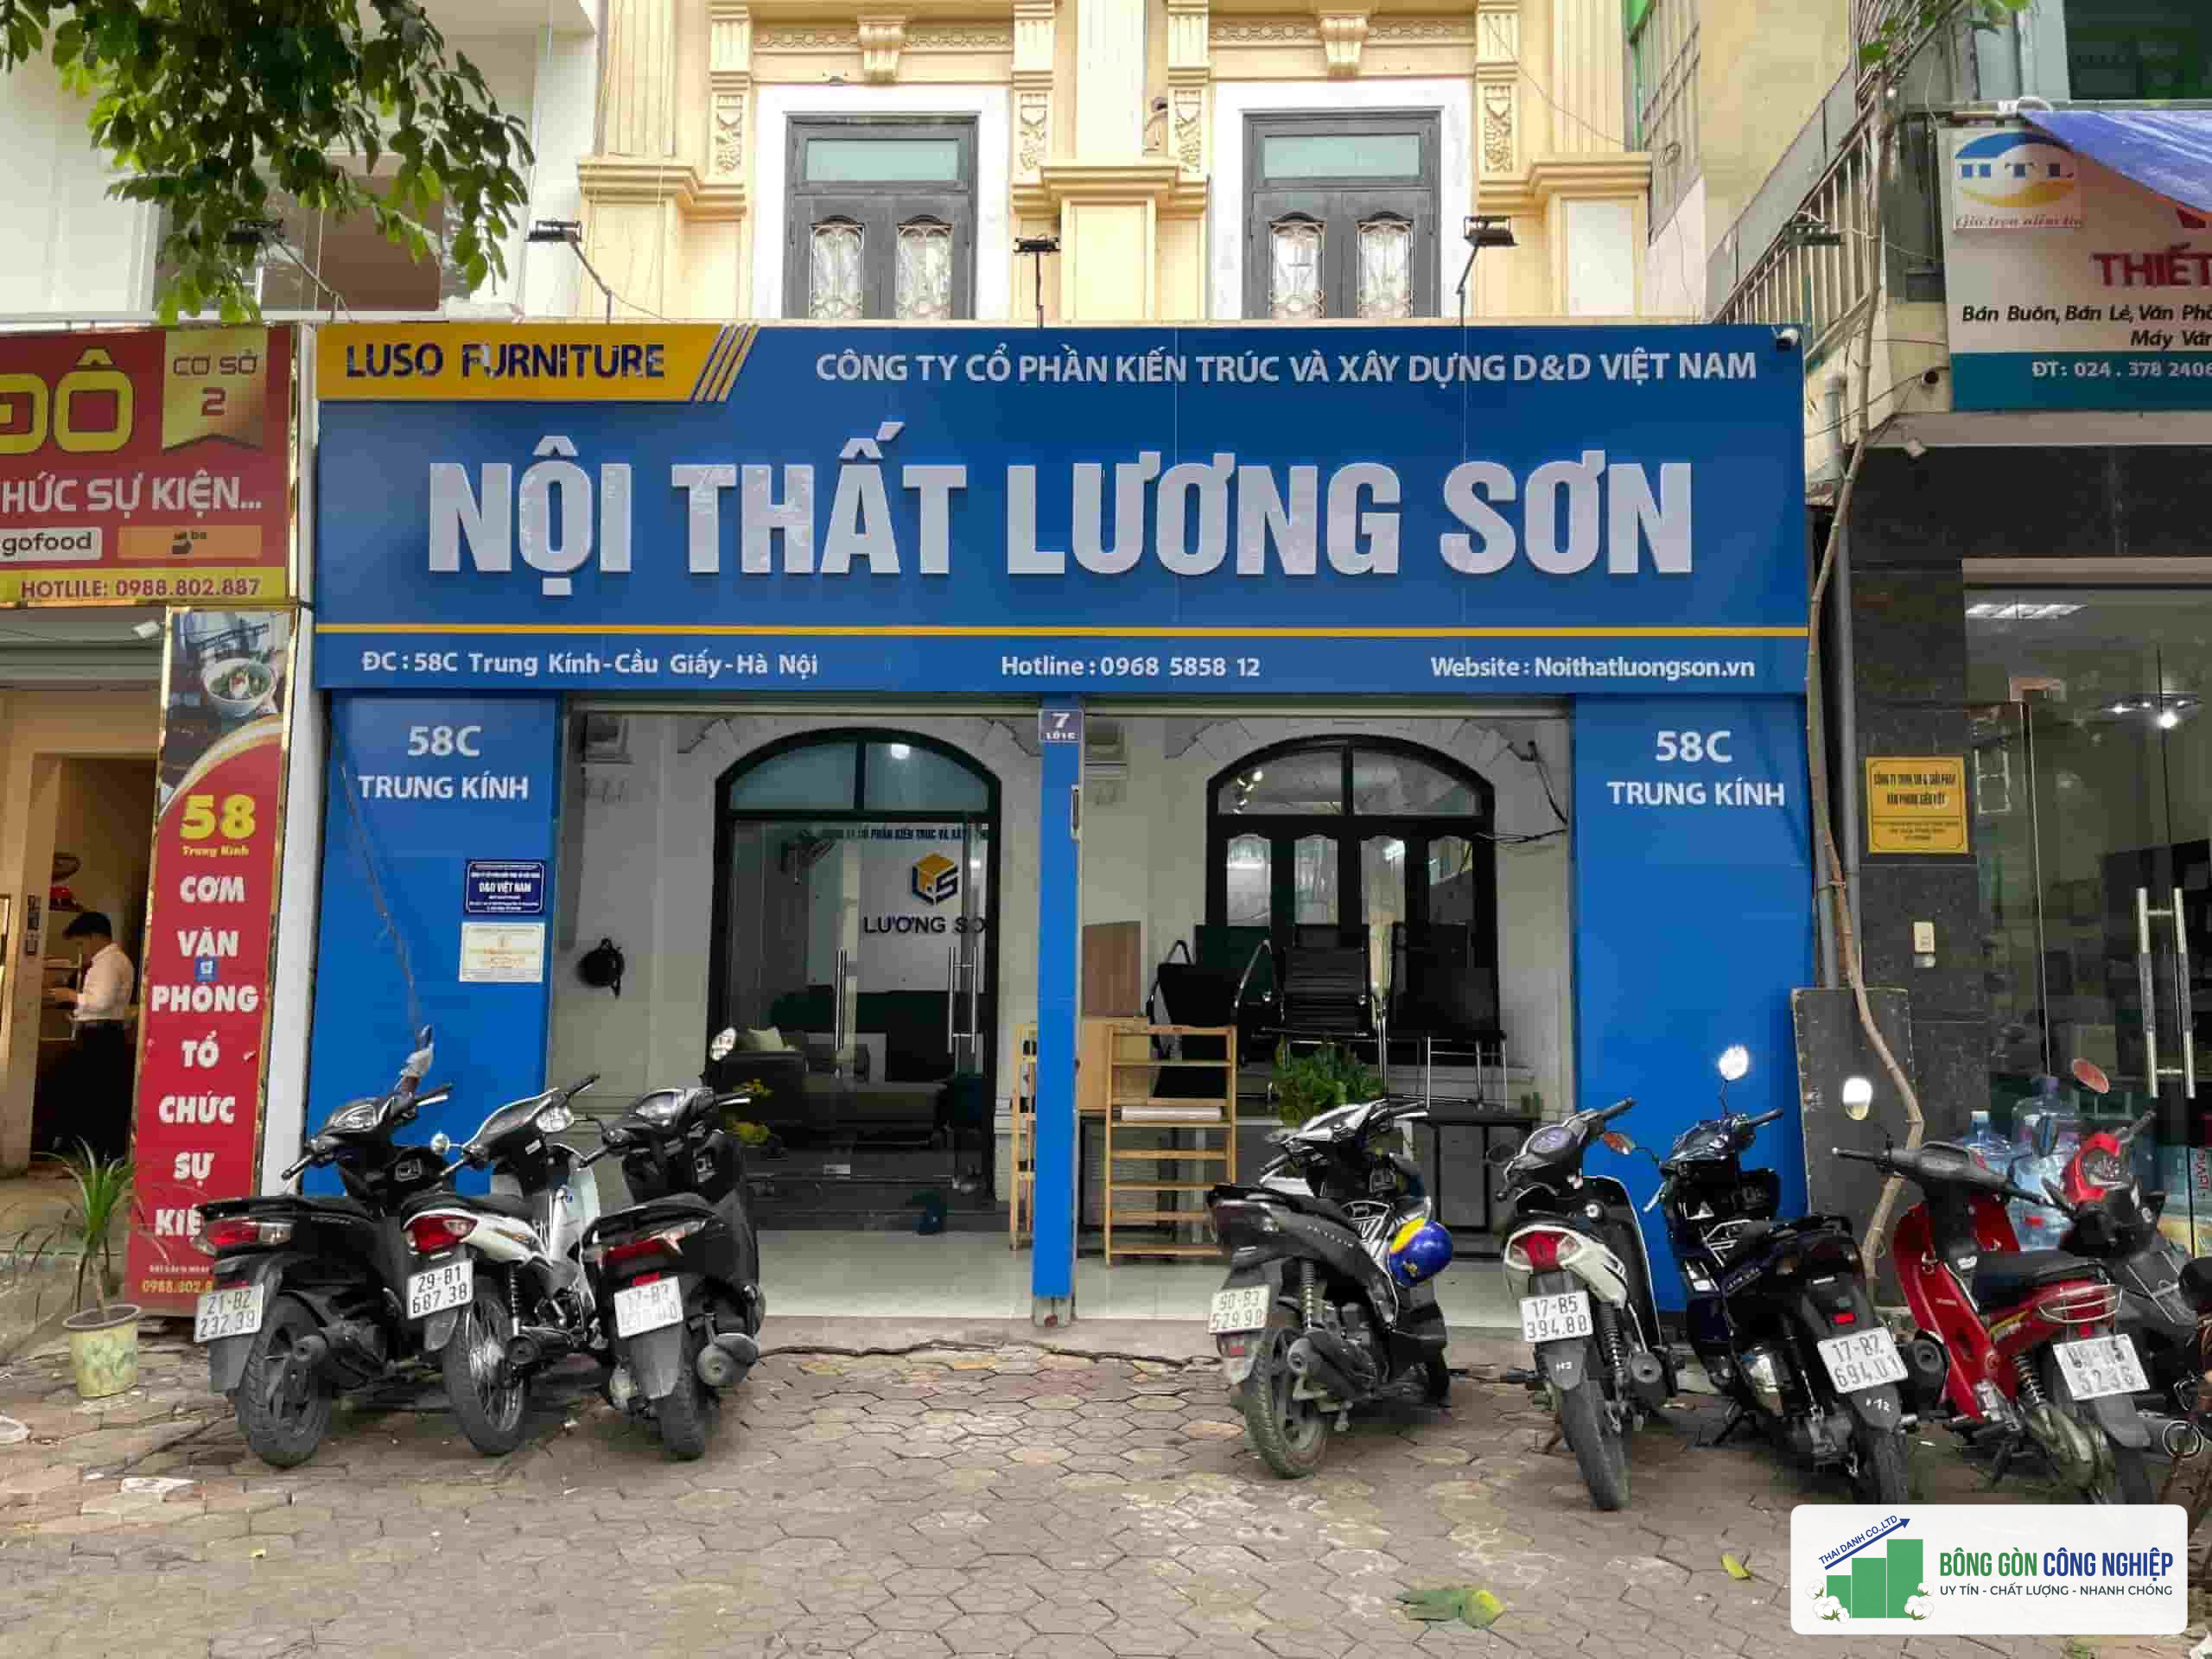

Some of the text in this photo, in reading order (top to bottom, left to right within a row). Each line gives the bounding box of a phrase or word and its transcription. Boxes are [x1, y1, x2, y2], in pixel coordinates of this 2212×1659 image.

[2131, 328, 2173, 352] Máy
[346, 343, 664, 378] LUSO FURNITURE
[816, 343, 1757, 389] CÔNG TY CỔ PHẦN KIẾN TRÚC VÀ XÂY DỰNG D&D VIỆT NAM
[2074, 360, 2111, 378] 024
[2128, 360, 2160, 378] 378
[200, 386, 226, 416] 2
[87, 472, 143, 519] SỰ
[428, 421, 1694, 596] NỘI THẤT LƯƠNG SƠN
[2, 533, 91, 556] gofood
[467, 653, 538, 676] Trung
[779, 652, 817, 679] Nội
[1169, 657, 1226, 677] 5858
[1237, 658, 1260, 677] 12
[1052, 713, 1071, 728] 7
[407, 725, 483, 758] 58C
[1656, 730, 1733, 763] 58C
[358, 770, 529, 800] TRUNG KÍNH
[1607, 777, 1785, 805] TRUNG KÍNH
[180, 794, 256, 841] 58
[180, 875, 245, 902] CƠM
[177, 926, 239, 957] VĂN
[159, 1090, 236, 1124] CHỨC
[173, 1152, 214, 1187] SỰ
